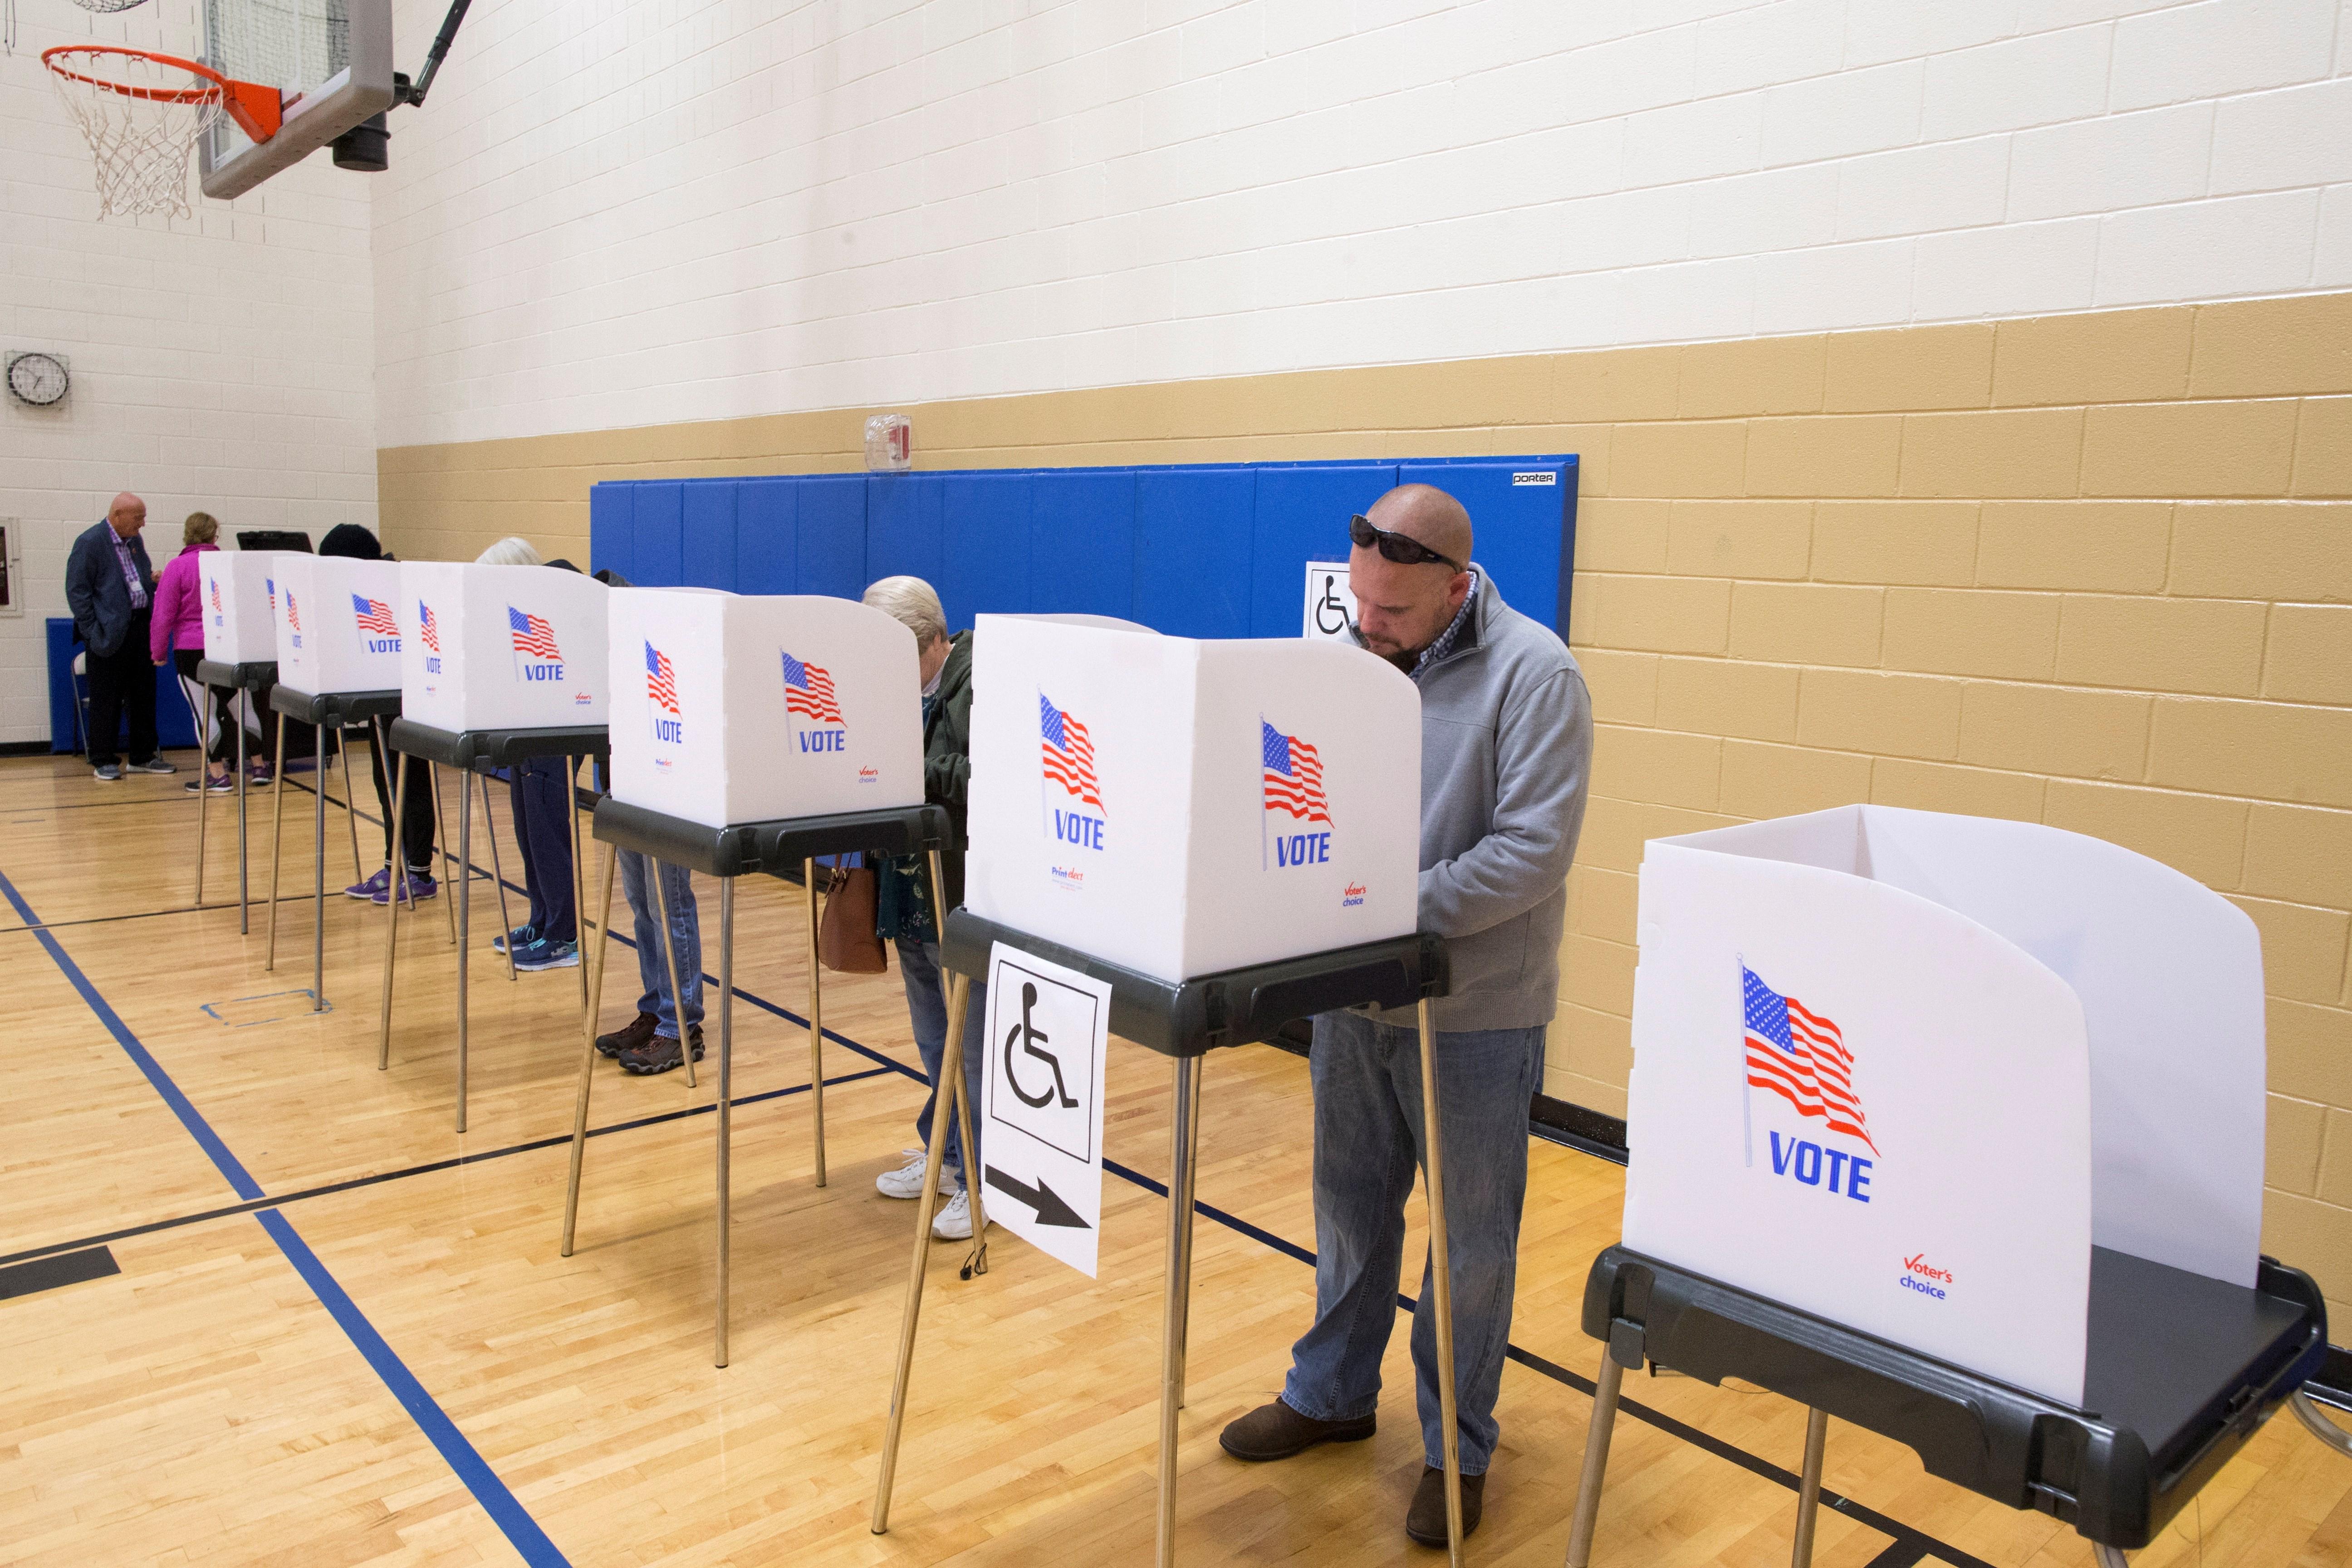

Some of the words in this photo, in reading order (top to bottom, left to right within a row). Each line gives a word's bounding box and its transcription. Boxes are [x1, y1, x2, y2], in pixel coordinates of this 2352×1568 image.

[1514, 474, 1553, 484] porter
[368, 639, 402, 653] VOTE
[426, 657, 441, 674] VOTE
[525, 664, 564, 681] VOTE
[656, 718, 682, 744] VOTE
[799, 730, 845, 752] VOTE
[859, 765, 878, 775] Voter's
[1055, 808, 1104, 851] VOTE
[1277, 832, 1331, 867] VOTE
[1344, 881, 1366, 897] Voter's
[1343, 896, 1363, 906] choice
[1769, 1130, 1873, 1204] VOTE
[1904, 1253, 1953, 1284] Voter's
[1900, 1275, 1946, 1300] choice
